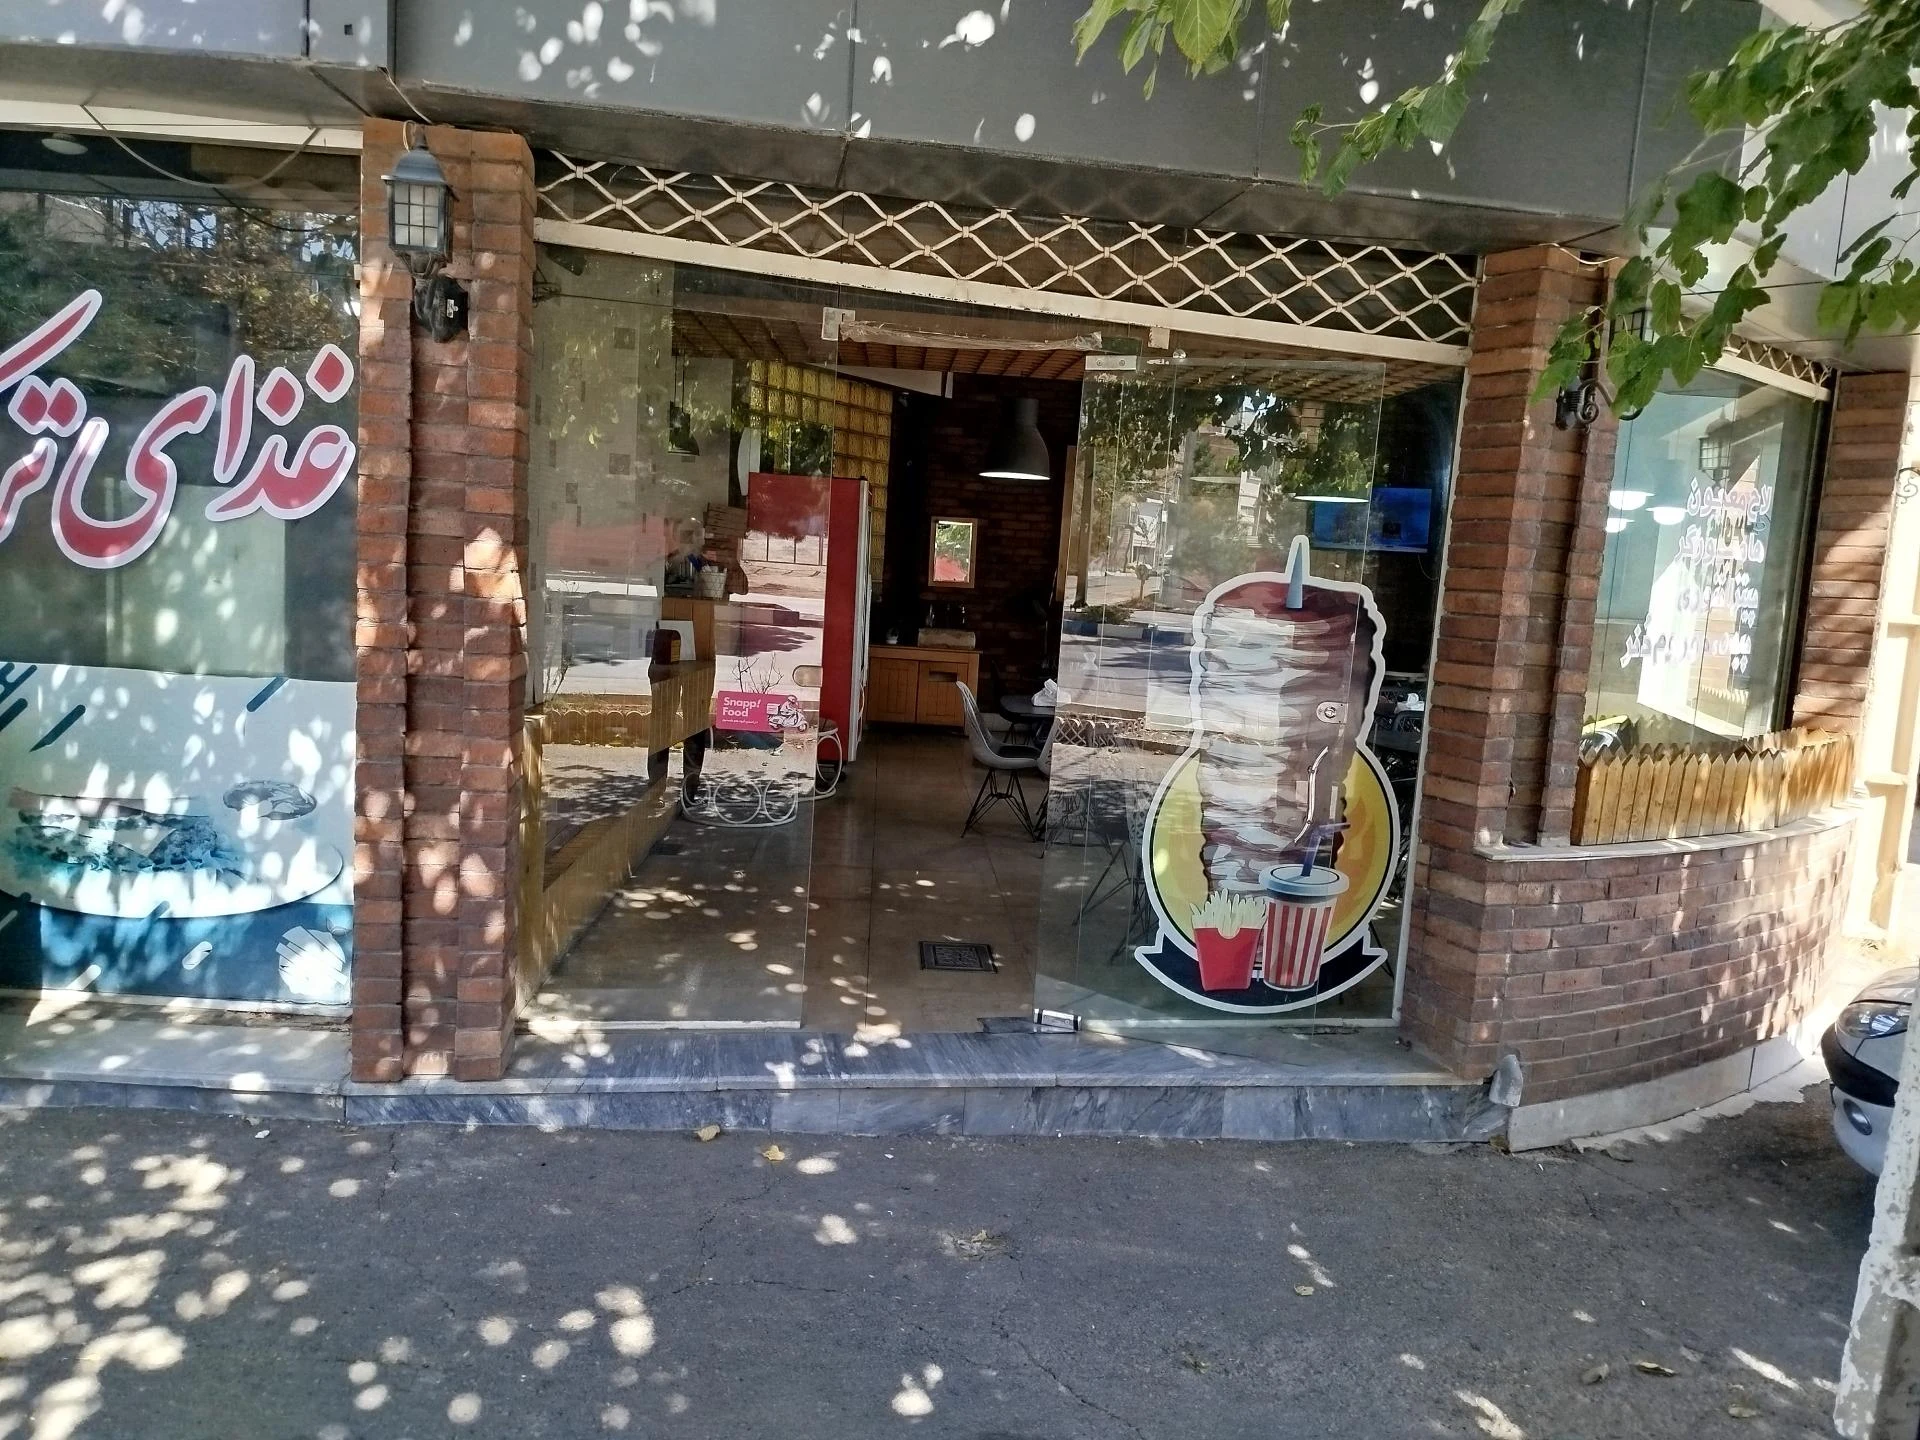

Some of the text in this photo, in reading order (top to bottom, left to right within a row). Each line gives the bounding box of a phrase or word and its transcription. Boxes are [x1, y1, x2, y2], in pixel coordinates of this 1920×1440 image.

[52, 344, 356, 569] غذای
[723, 696, 762, 710] Snapp!
[722, 707, 749, 717] Food
